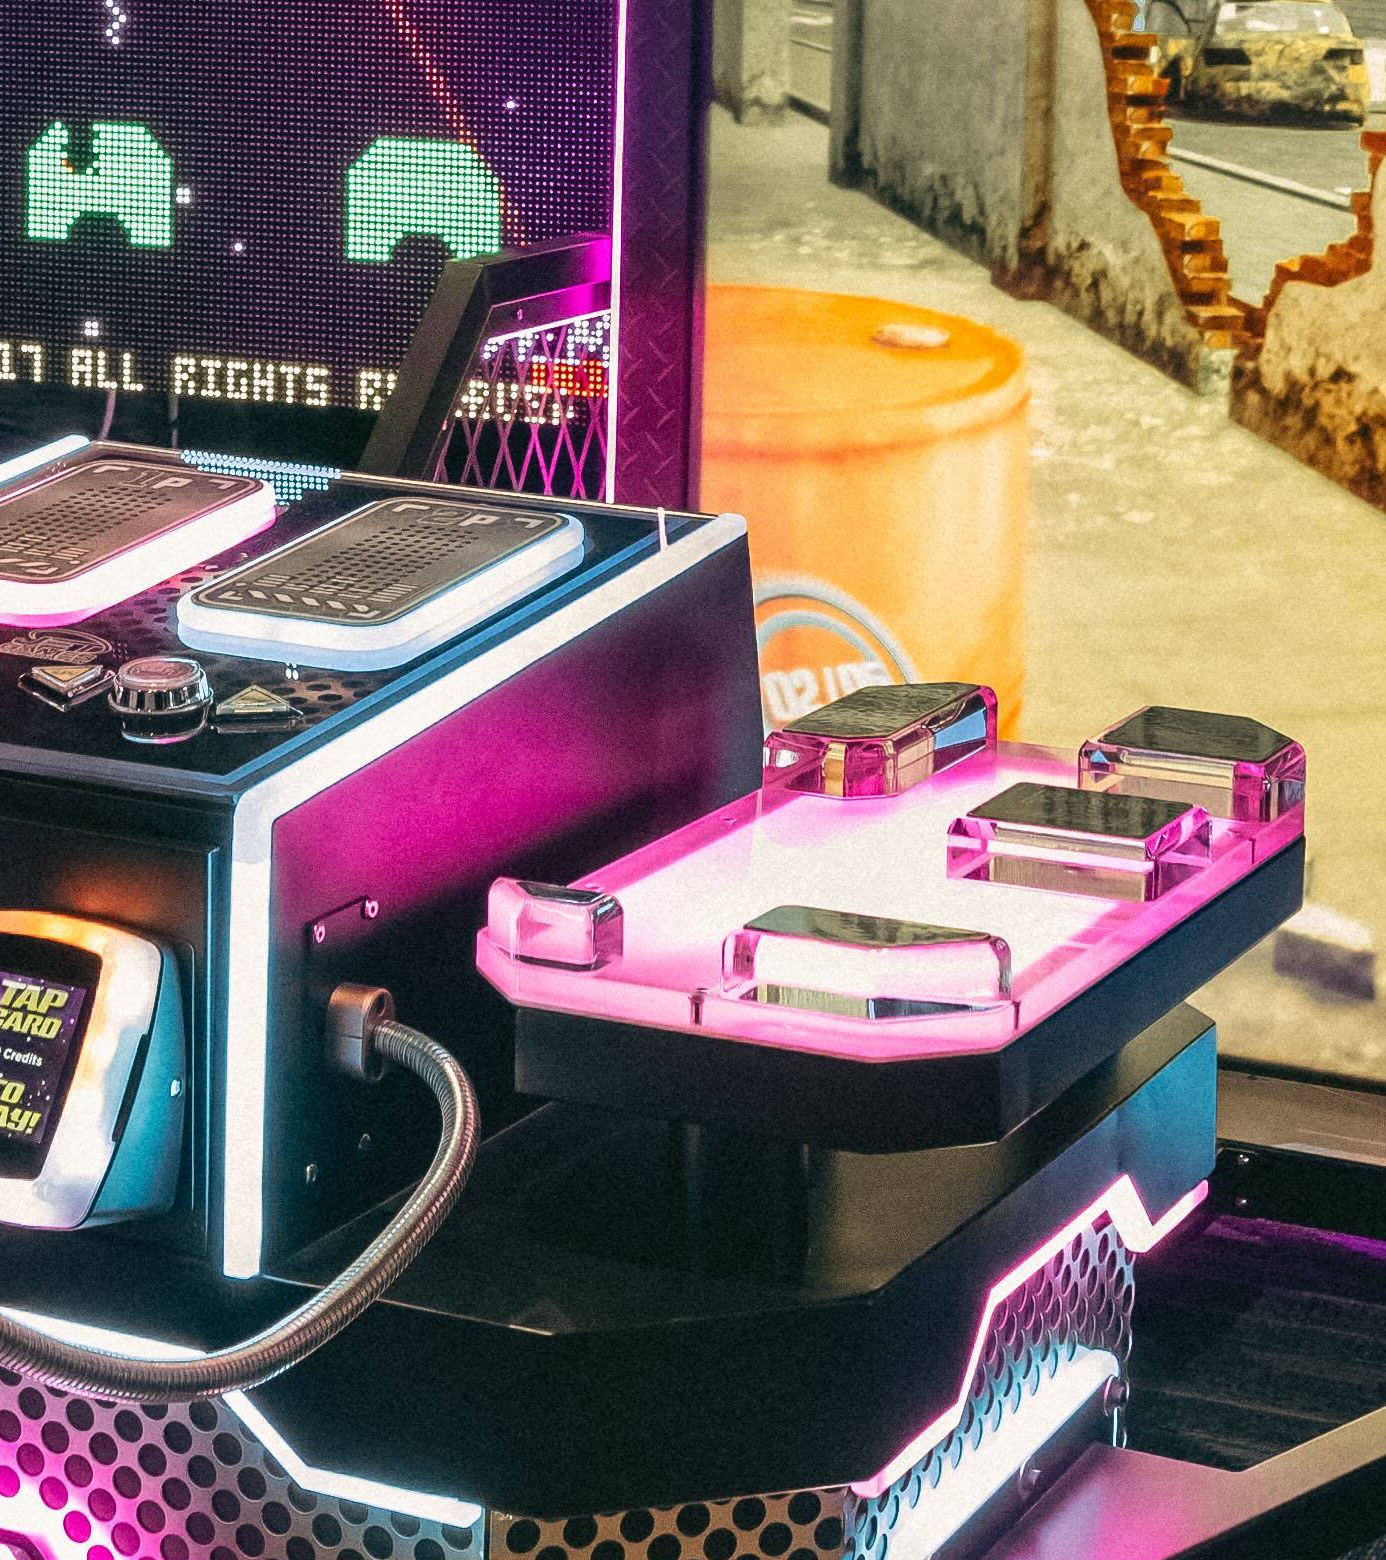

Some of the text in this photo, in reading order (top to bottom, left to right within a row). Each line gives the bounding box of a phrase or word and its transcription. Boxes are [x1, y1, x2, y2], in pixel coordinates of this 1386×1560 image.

[71, 348, 144, 392] ALL
[174, 356, 328, 406] RIGHTS
[0, 978, 69, 1014] TAP
[3, 1048, 43, 1067] Credits
